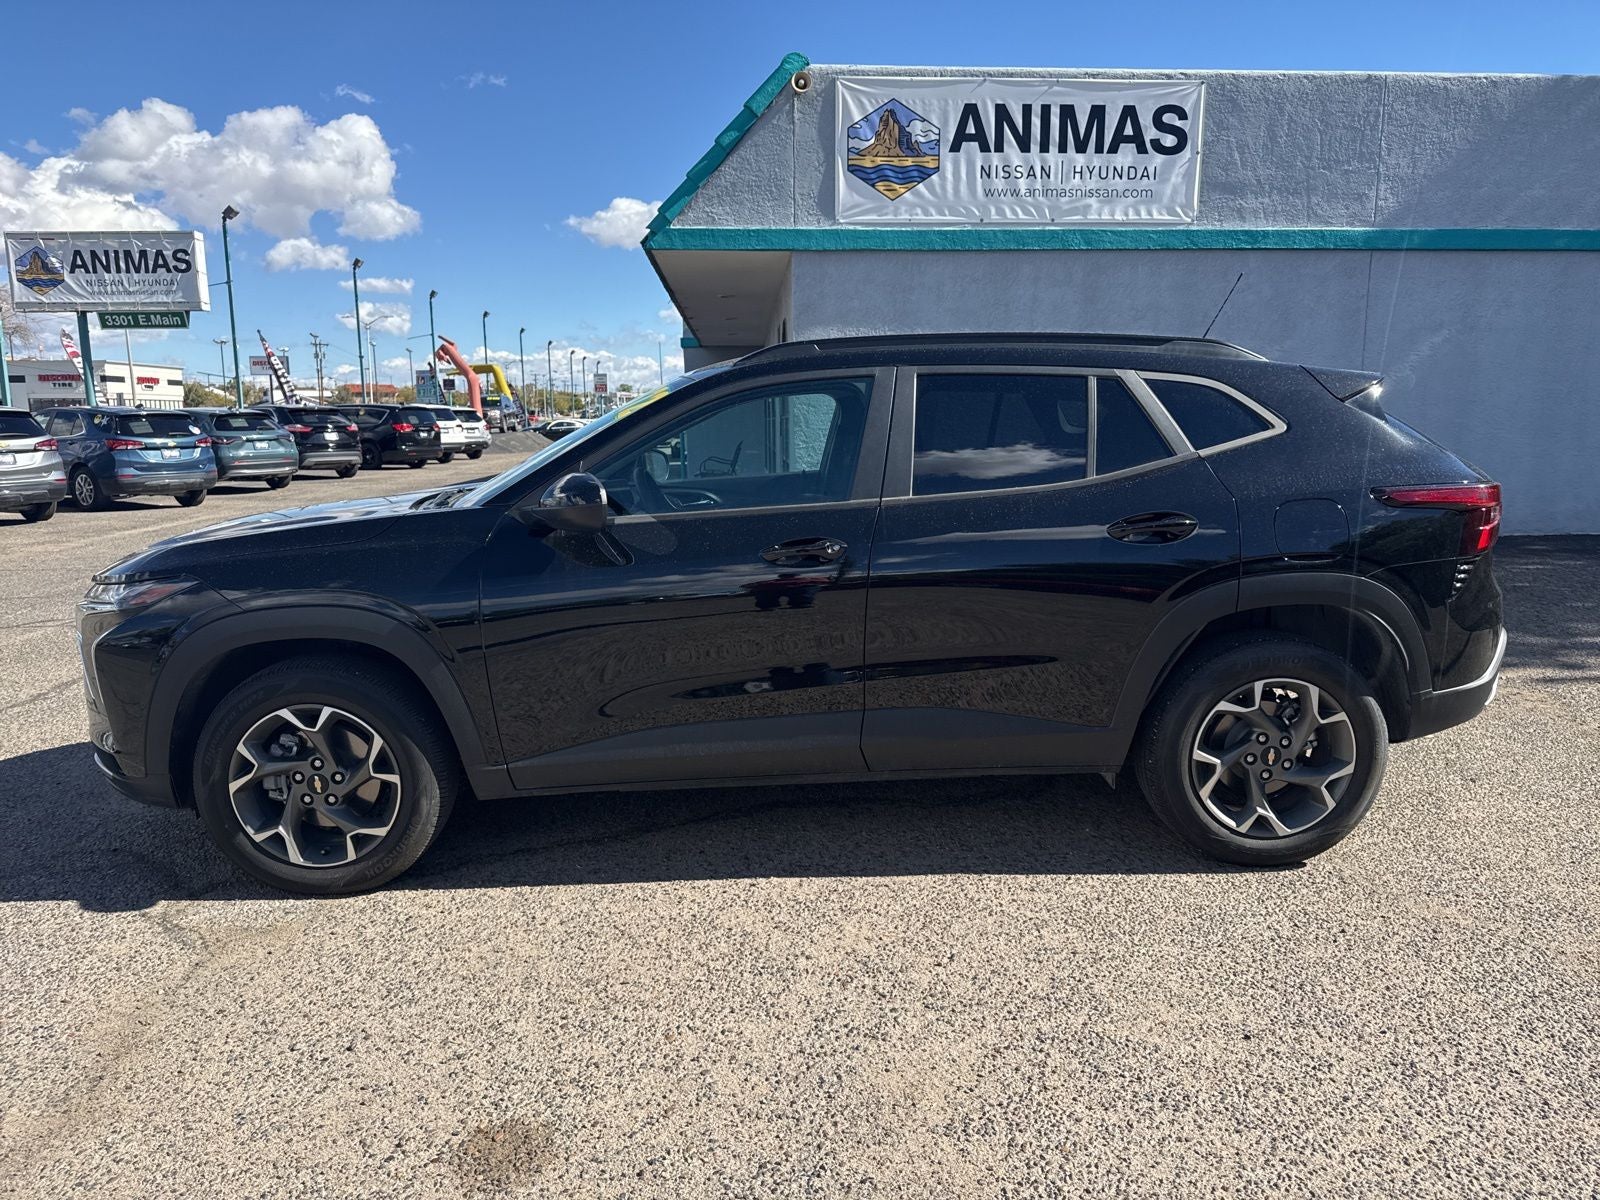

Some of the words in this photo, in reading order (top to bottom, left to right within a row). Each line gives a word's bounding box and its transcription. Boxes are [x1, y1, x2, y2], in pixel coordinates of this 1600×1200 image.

[948, 102, 1189, 156] ANIMAS
[980, 164, 1052, 180] NISSAN
[1072, 165, 1158, 181] HYUNDAI
[983, 185, 1154, 199] www.animasnissan.com
[69, 248, 192, 274] ANIMAS
[86, 278, 124, 287] NISSAN
[104, 314, 135, 326] 3301
